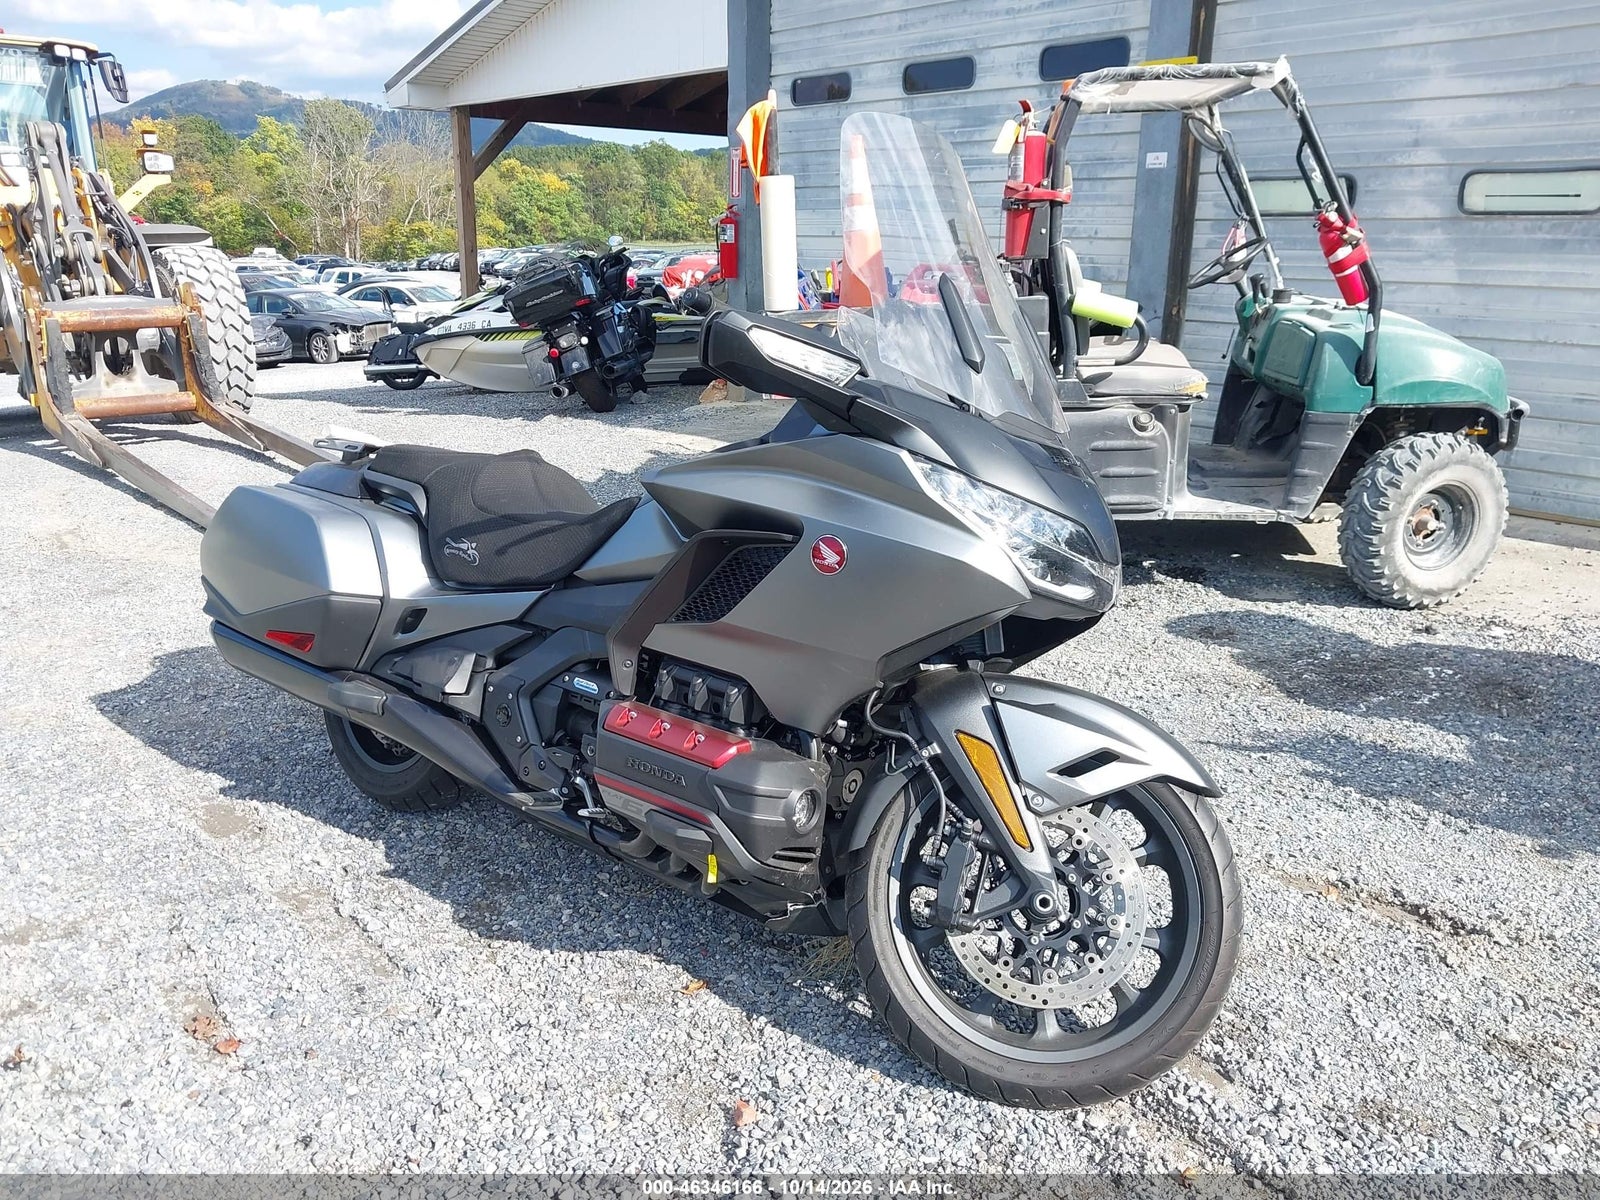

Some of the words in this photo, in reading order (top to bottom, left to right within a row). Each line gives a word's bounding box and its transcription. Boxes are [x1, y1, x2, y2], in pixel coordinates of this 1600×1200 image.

[457, 321, 477, 331] 4336
[481, 319, 492, 329] CA
[627, 757, 686, 787] HONDA
